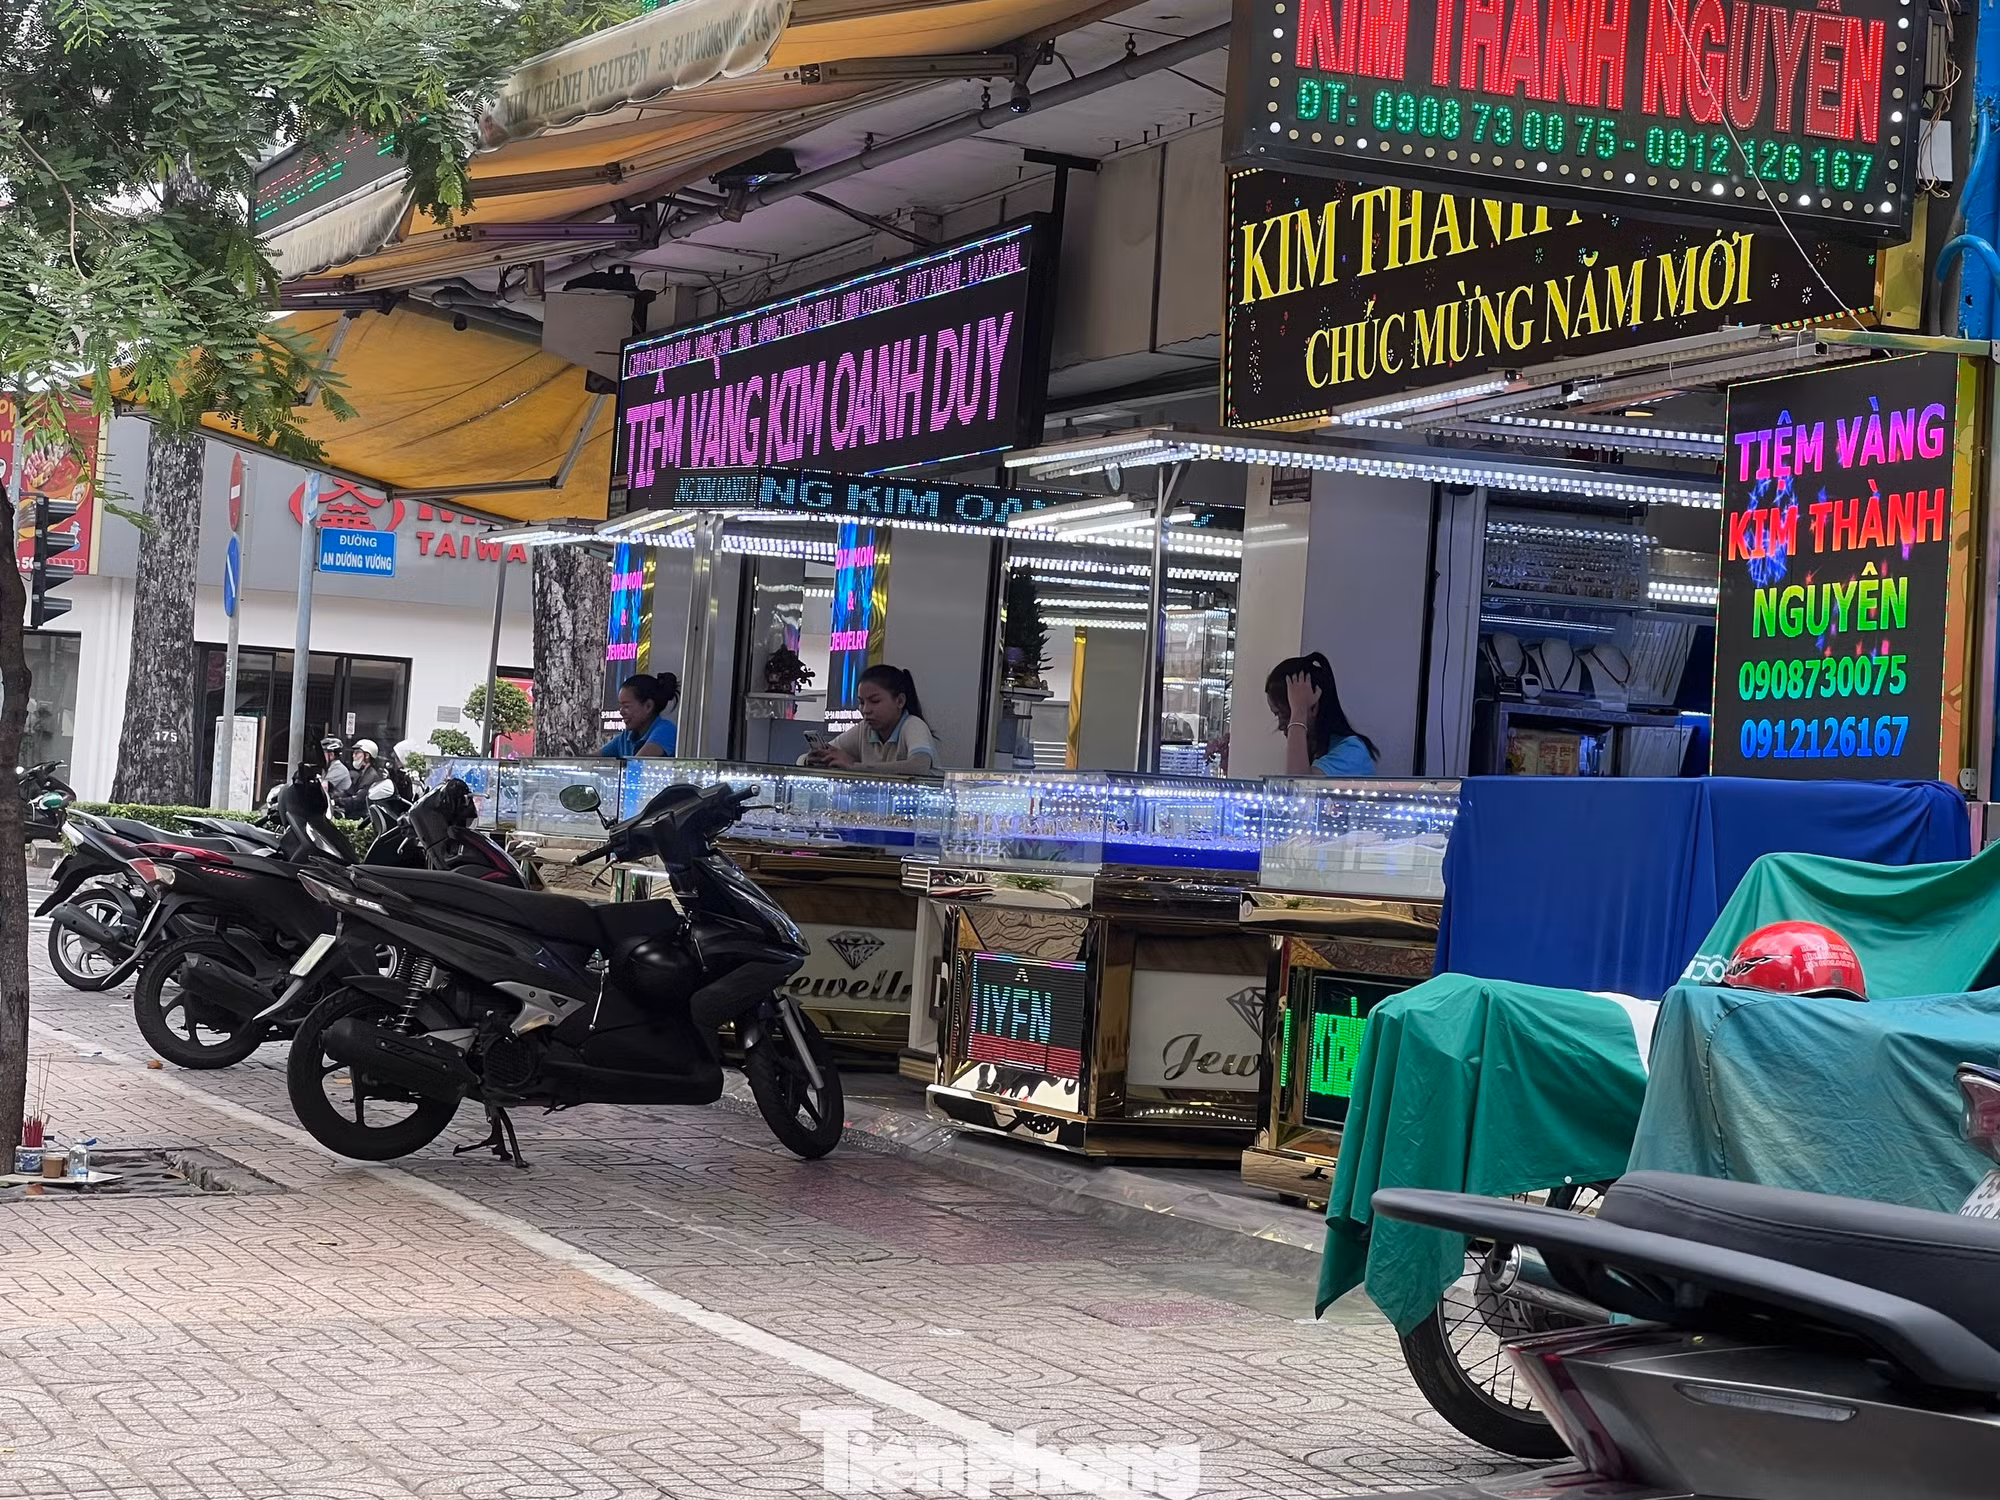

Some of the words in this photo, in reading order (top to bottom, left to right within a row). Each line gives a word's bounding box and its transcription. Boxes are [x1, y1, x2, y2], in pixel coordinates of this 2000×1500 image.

[1295, 0, 1410, 81] KIM
[1296, 77, 1358, 126] ĐT:
[1373, 89, 1462, 140] 0908
[1472, 102, 1514, 147] 73
[1522, 109, 1566, 154] 00
[1645, 126, 1731, 175] 0912
[1743, 138, 1803, 184] 126
[1811, 147, 1873, 193] 167
[1239, 199, 1341, 305] KIM
[1306, 298, 1406, 389] CHÚC
[1412, 280, 1535, 370] MỪNG
[1542, 250, 1649, 344] NĂM
[1653, 229, 1755, 321] MỚI
[764, 360, 828, 466] KIM
[829, 334, 928, 451] OANH
[929, 311, 1015, 431] DUY
[1735, 410, 1825, 491] TIỆM
[1836, 396, 1947, 469] VÀNG
[847, 483, 940, 517] KIM
[1728, 502, 1800, 561] KIM
[1808, 479, 1946, 554] THÀNH
[322, 552, 334, 565] AN
[339, 533, 378, 547] ĐƯỜNG
[1752, 561, 1909, 639] NGUYÊN
[1739, 655, 1907, 701] 0908730075
[155, 731, 178, 742] 175
[1741, 716, 1909, 759] 0912126167
